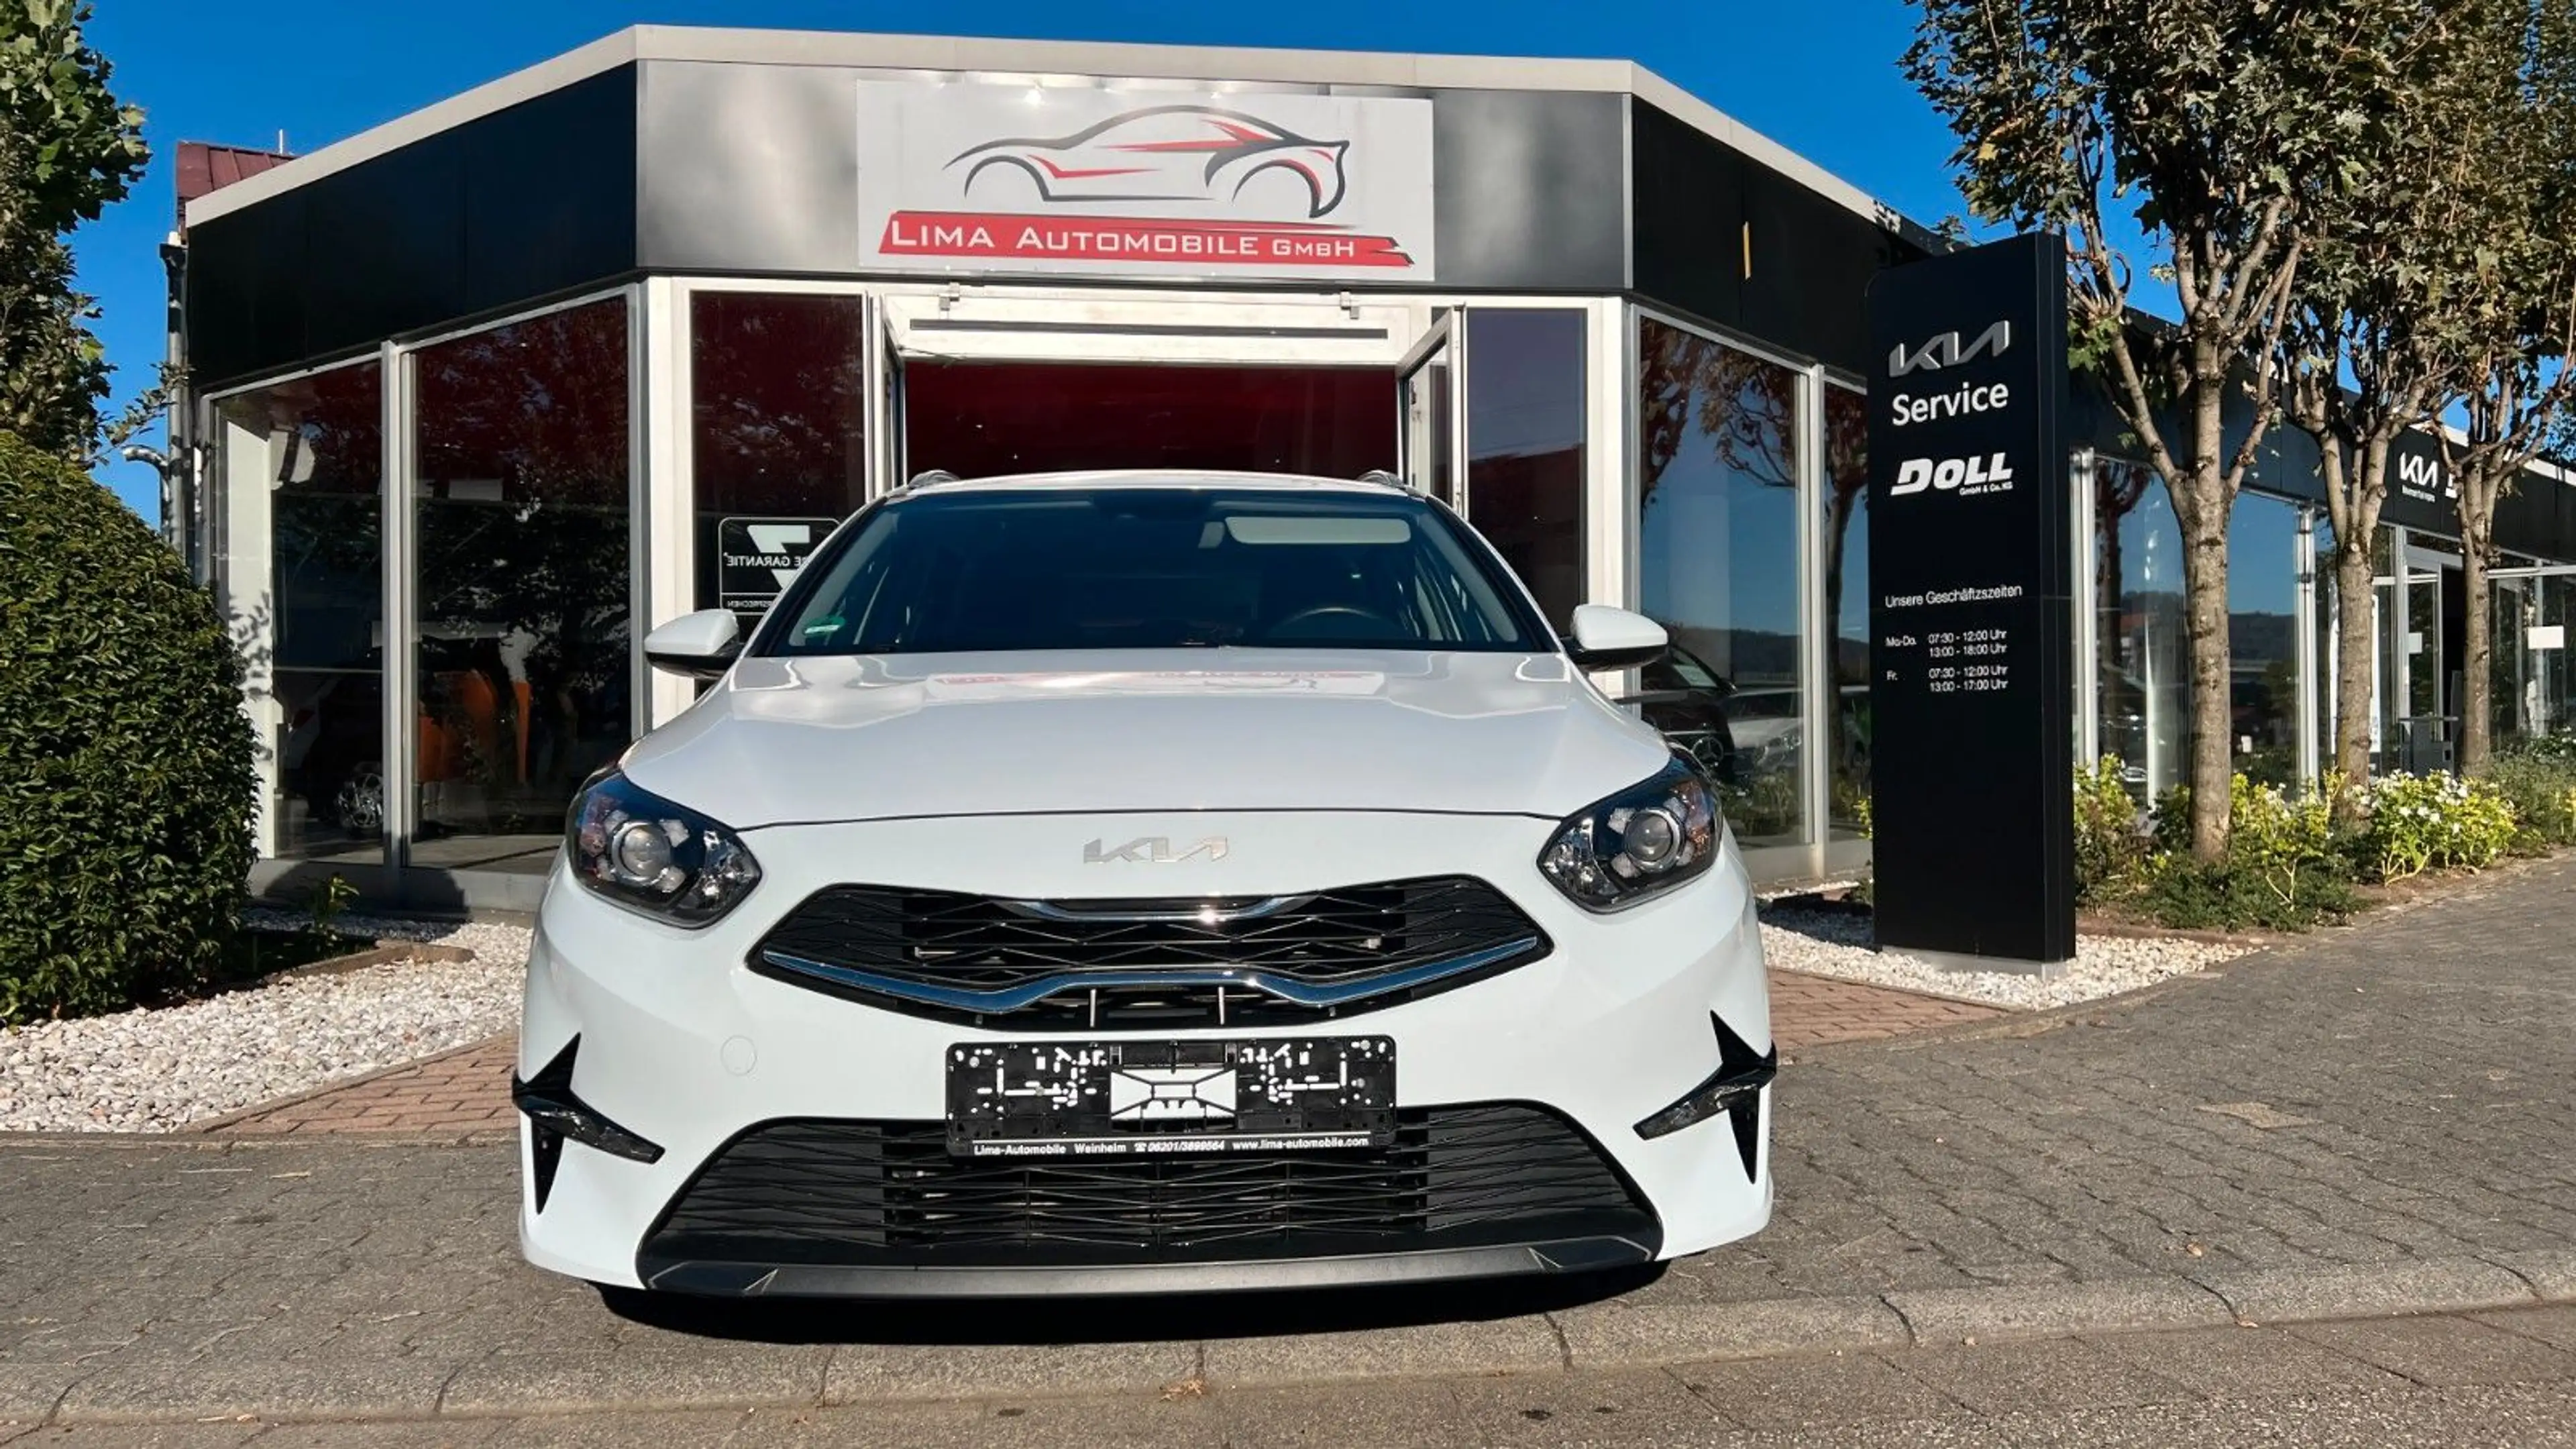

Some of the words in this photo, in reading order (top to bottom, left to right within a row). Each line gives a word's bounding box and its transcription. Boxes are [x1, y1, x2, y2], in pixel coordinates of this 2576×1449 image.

[891, 220, 996, 249] LIMA
[1016, 225, 1259, 256] AUTOMOBILE
[1888, 319, 2010, 378] KIA
[1892, 382, 2009, 426] Service
[1890, 451, 2013, 496] DOLL
[1884, 594, 1924, 608] Unsere
[1928, 633, 1954, 645] 07:30
[1963, 629, 1988, 641] 12:00
[1990, 629, 2007, 640] Uhr
[1929, 645, 1954, 657] 13:00
[1963, 644, 1988, 655] 18:00
[1990, 643, 2007, 655] Uhr
[1929, 667, 1955, 679] 07:30
[1964, 665, 1990, 677] 12:00
[1990, 665, 2008, 676] Uhr
[1930, 681, 1955, 692] 13:00
[1964, 679, 1990, 690] 17:00
[1990, 679, 2008, 690] Uhr
[1083, 837, 1227, 864] KIA
[973, 1143, 1067, 1156] Lima-Automobile
[1074, 1142, 1127, 1155] Weinheim
[1232, 1136, 1370, 1150] www.lima-automobile.com
